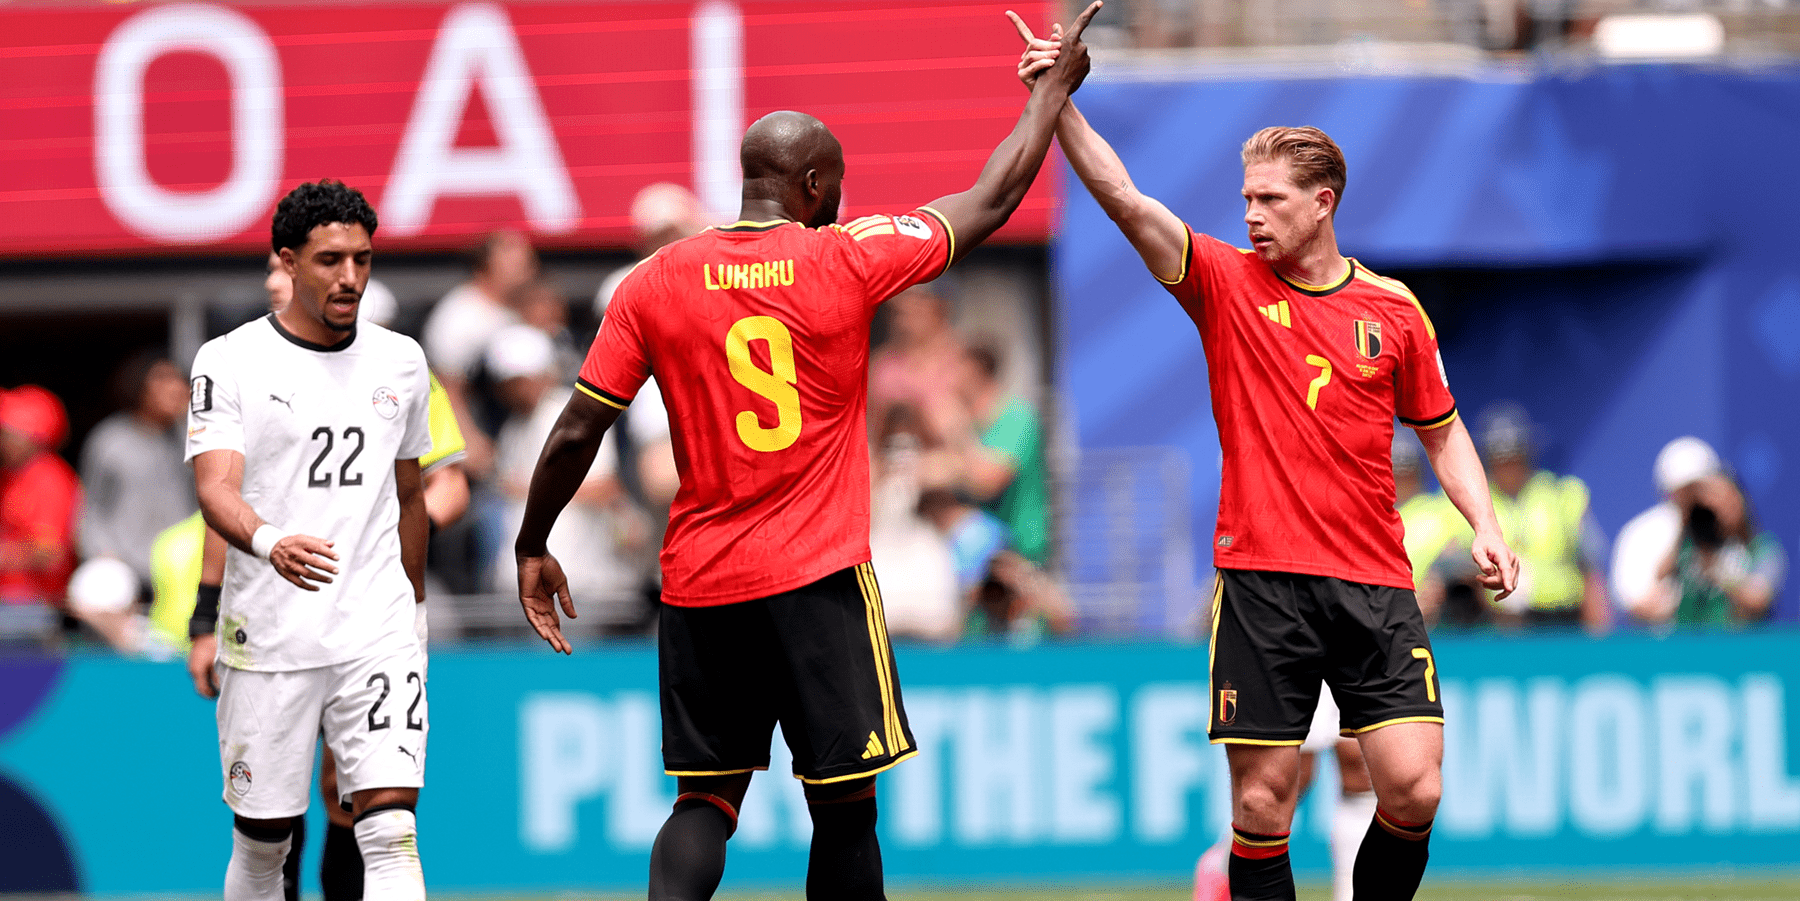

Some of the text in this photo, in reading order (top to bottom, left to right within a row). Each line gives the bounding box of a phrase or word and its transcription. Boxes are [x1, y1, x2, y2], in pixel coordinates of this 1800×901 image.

[703, 259, 794, 290] LUKAKU
[725, 315, 802, 452] 9
[1305, 354, 1332, 411] 7
[308, 426, 365, 488] 22
[366, 671, 422, 731] 22
[1411, 647, 1437, 703] 7
[889, 682, 1120, 845] THE
